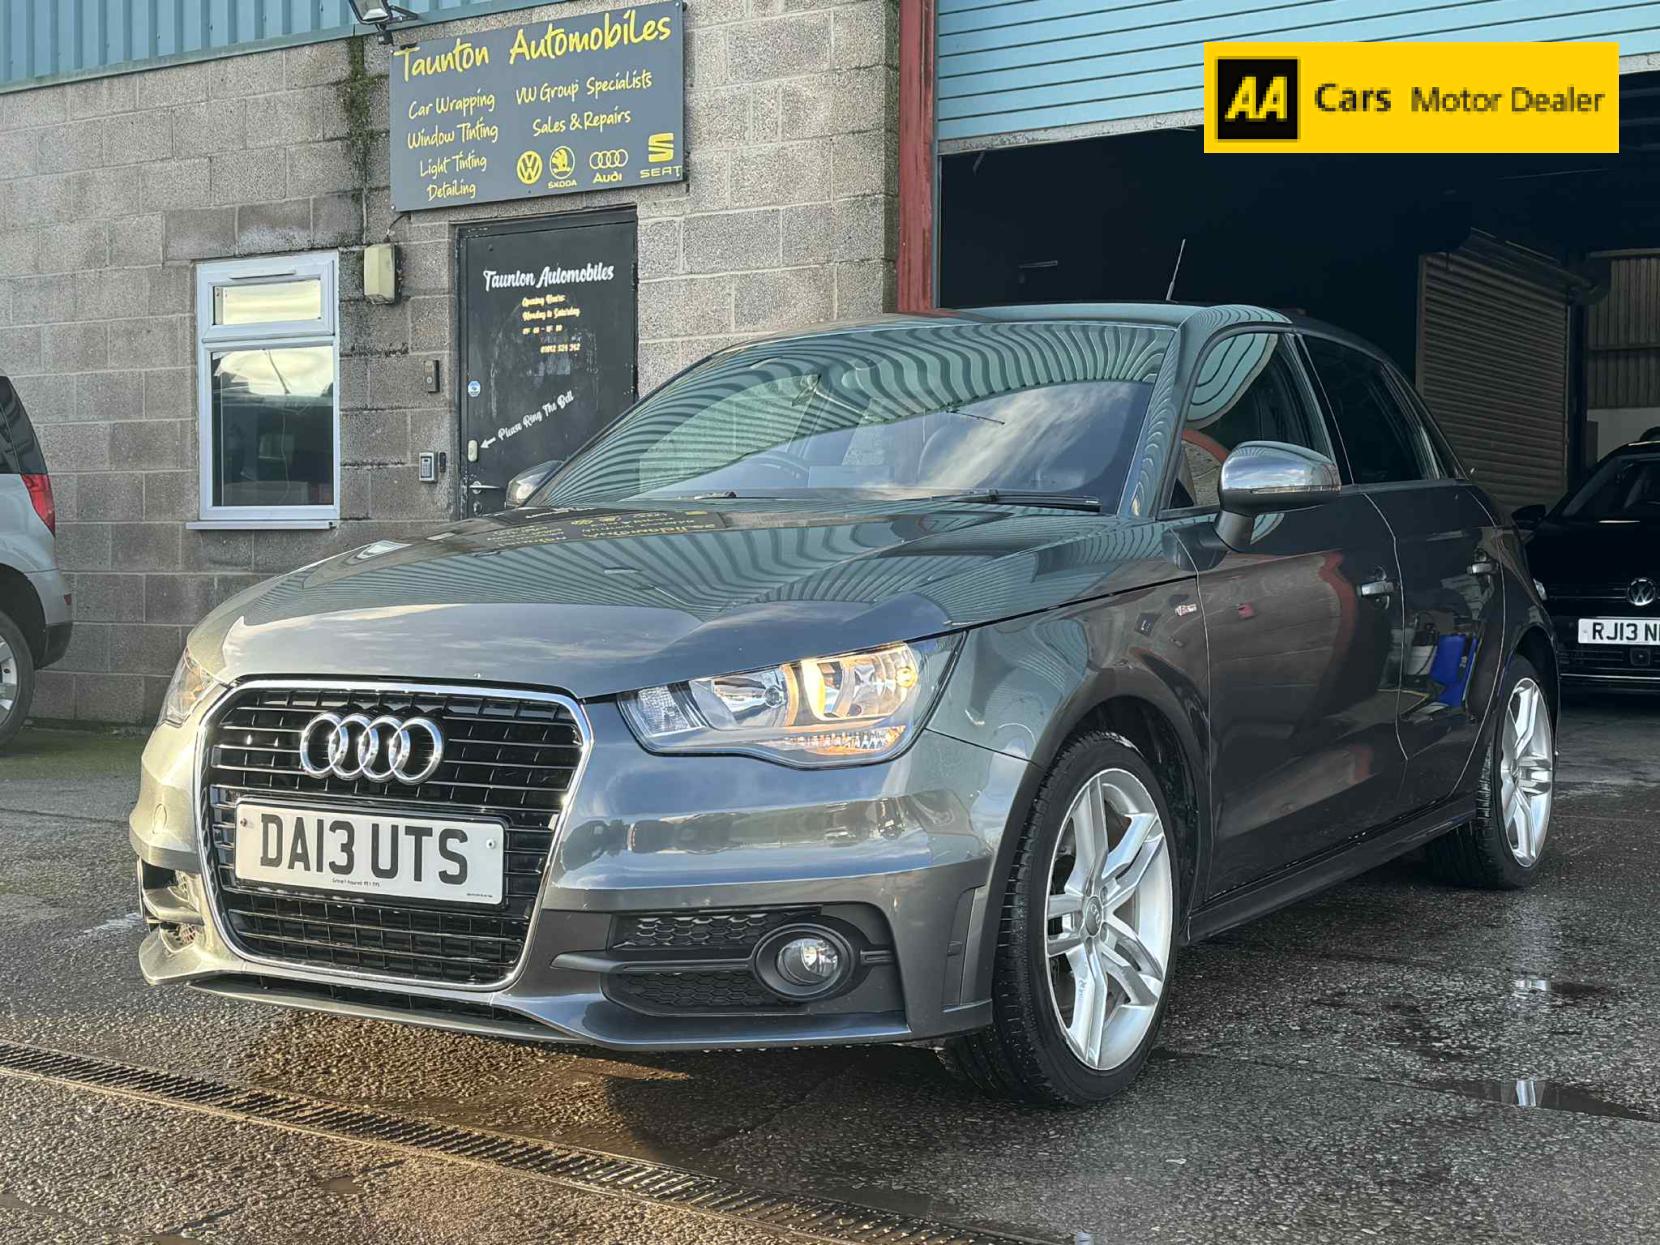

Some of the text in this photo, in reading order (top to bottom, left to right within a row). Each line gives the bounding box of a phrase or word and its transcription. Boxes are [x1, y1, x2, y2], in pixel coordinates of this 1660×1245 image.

[393, 9, 672, 82] Taunton Automobiles
[516, 69, 653, 105] VW Group Specialists
[408, 89, 495, 120] Car Wrapping
[407, 117, 498, 150] Window Tinting
[532, 105, 631, 137] Sales & Repairs
[420, 150, 487, 179] Light Tinting
[592, 171, 623, 184] Audi
[640, 166, 682, 178] SEAT
[427, 180, 477, 202] Detailing
[483, 262, 615, 292] Taunton Automobiles
[498, 390, 575, 440] Please Ring The Bell
[1592, 622, 1638, 641] RJ13
[260, 813, 469, 886] DA13 UTS
